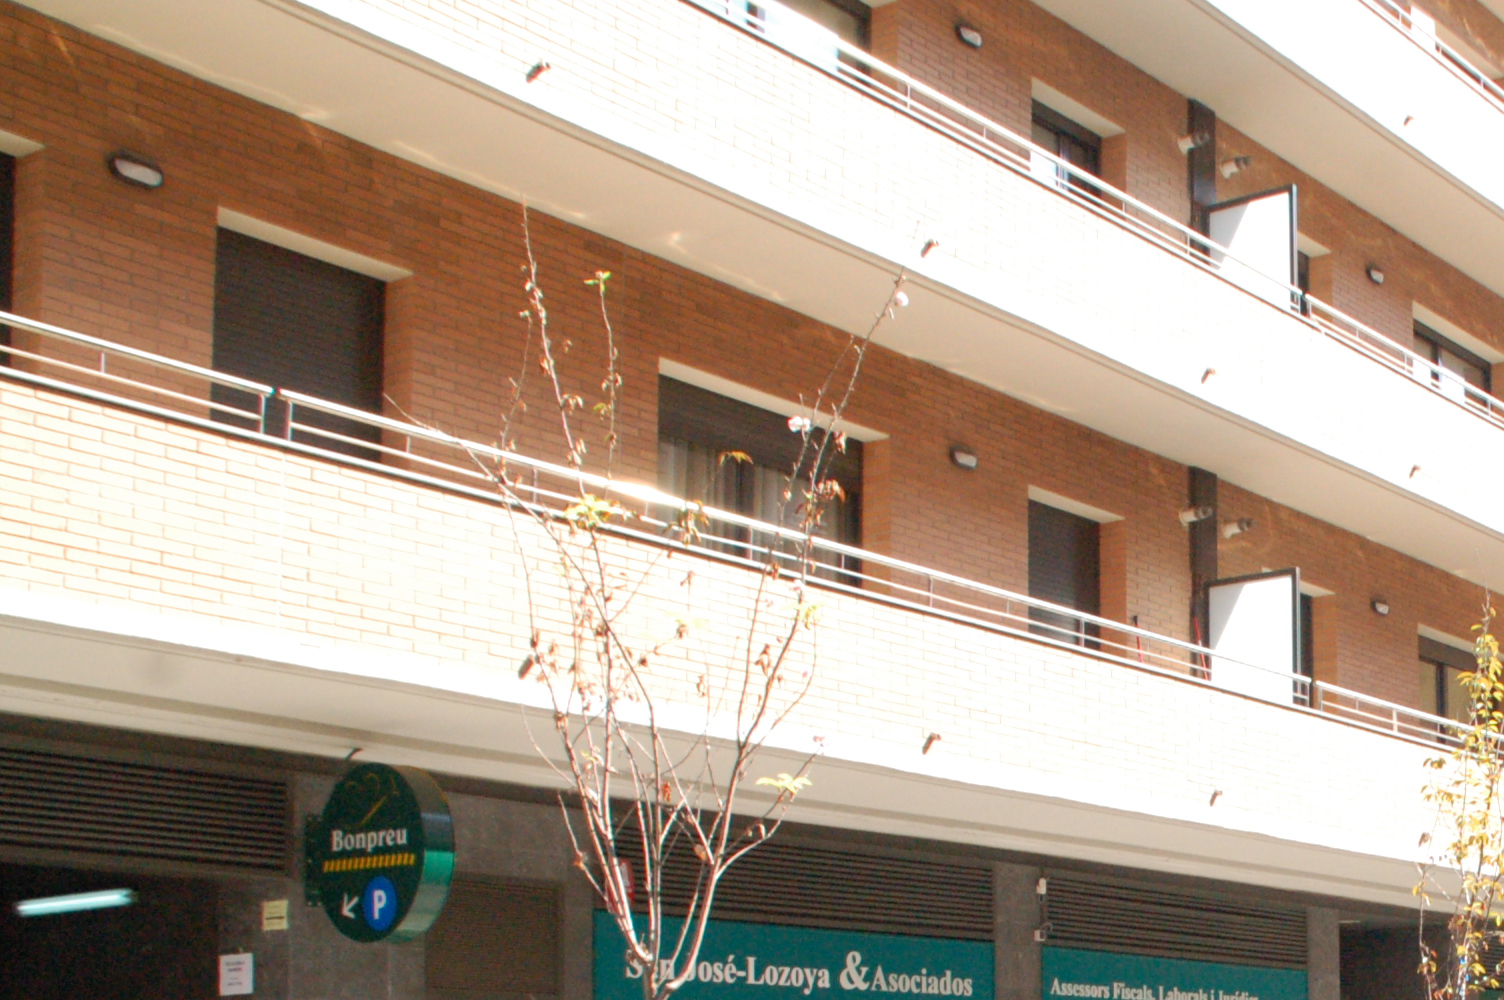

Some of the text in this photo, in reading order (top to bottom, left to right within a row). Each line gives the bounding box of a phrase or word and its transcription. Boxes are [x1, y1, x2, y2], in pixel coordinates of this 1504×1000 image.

[331, 827, 408, 852] Bonpreu
[373, 889, 387, 920] P
[1050, 977, 1110, 999] Assessors
